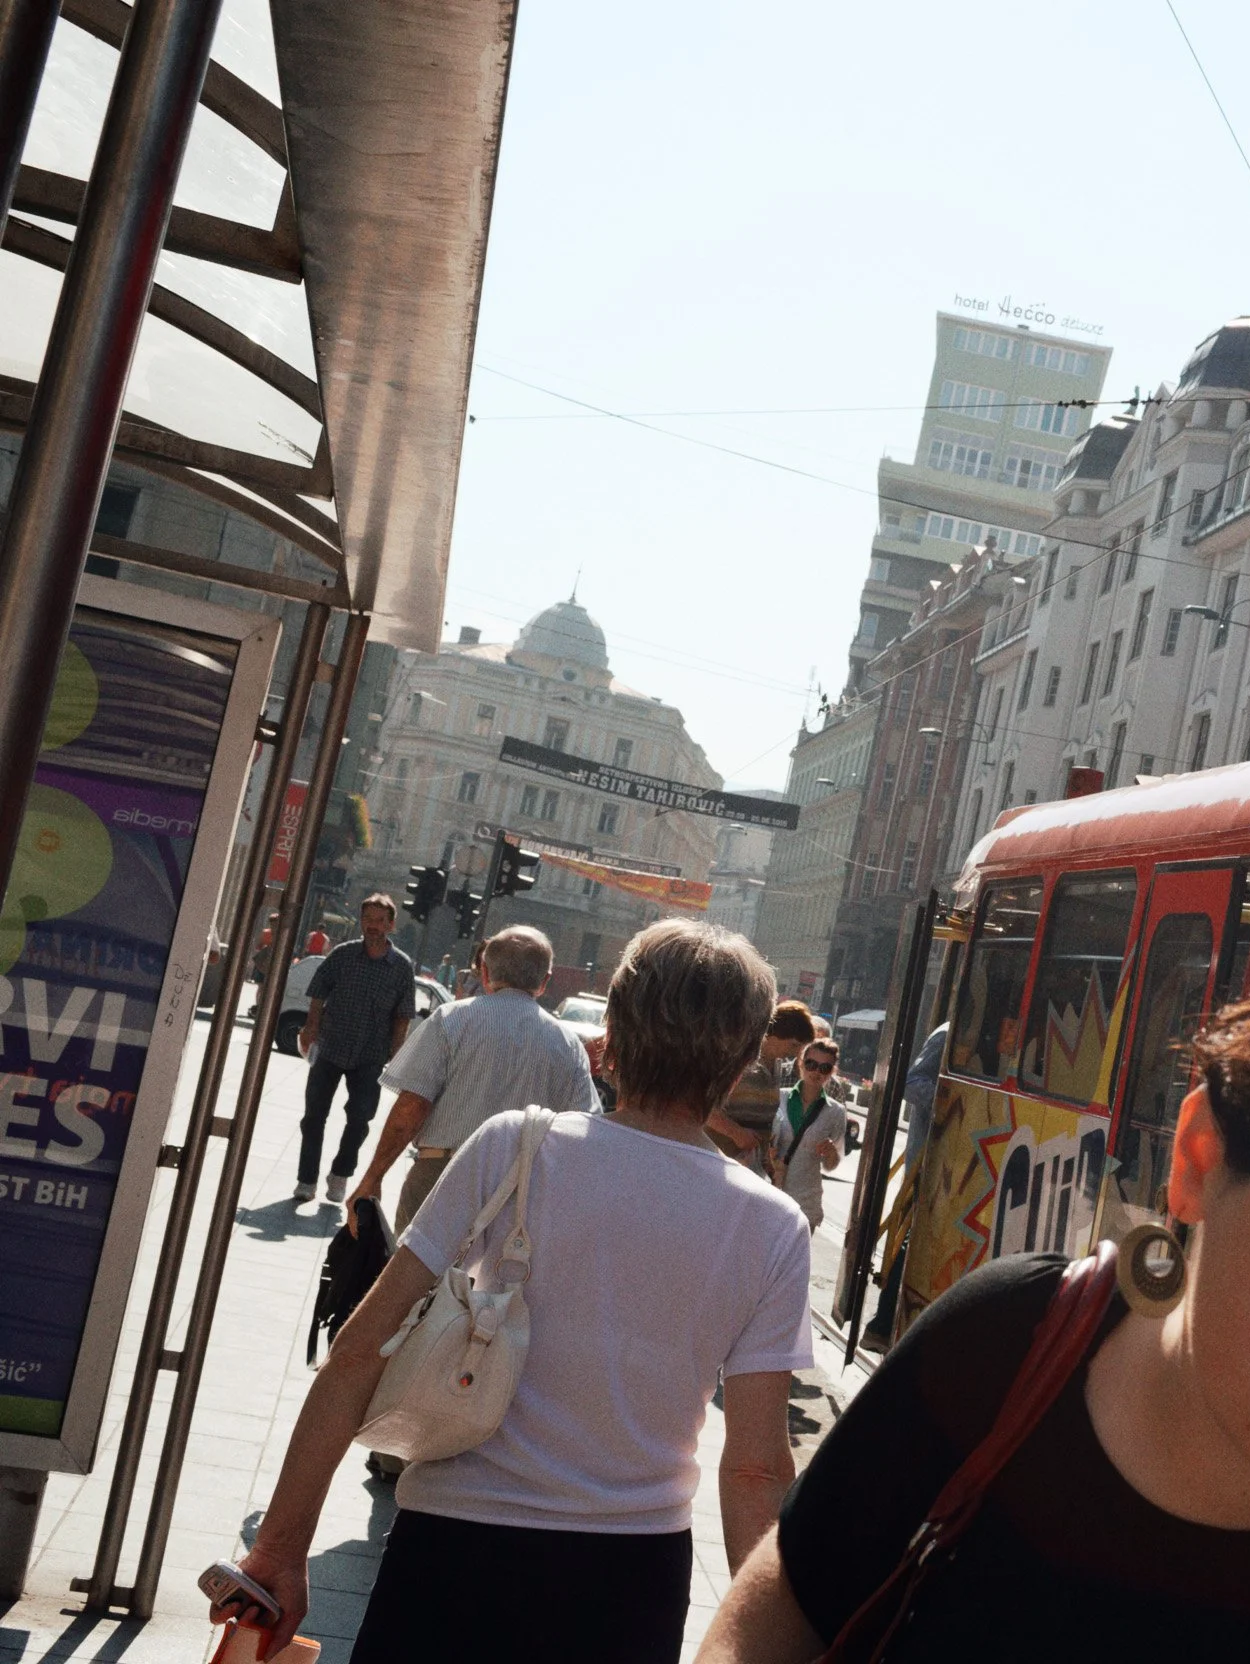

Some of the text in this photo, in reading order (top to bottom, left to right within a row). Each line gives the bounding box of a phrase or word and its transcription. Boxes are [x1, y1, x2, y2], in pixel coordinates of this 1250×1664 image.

[954, 293, 990, 311] hotel
[577, 768, 631, 796] NESIM
[274, 803, 303, 862] ESPRIT
[34, 1180, 89, 1210] BiH
